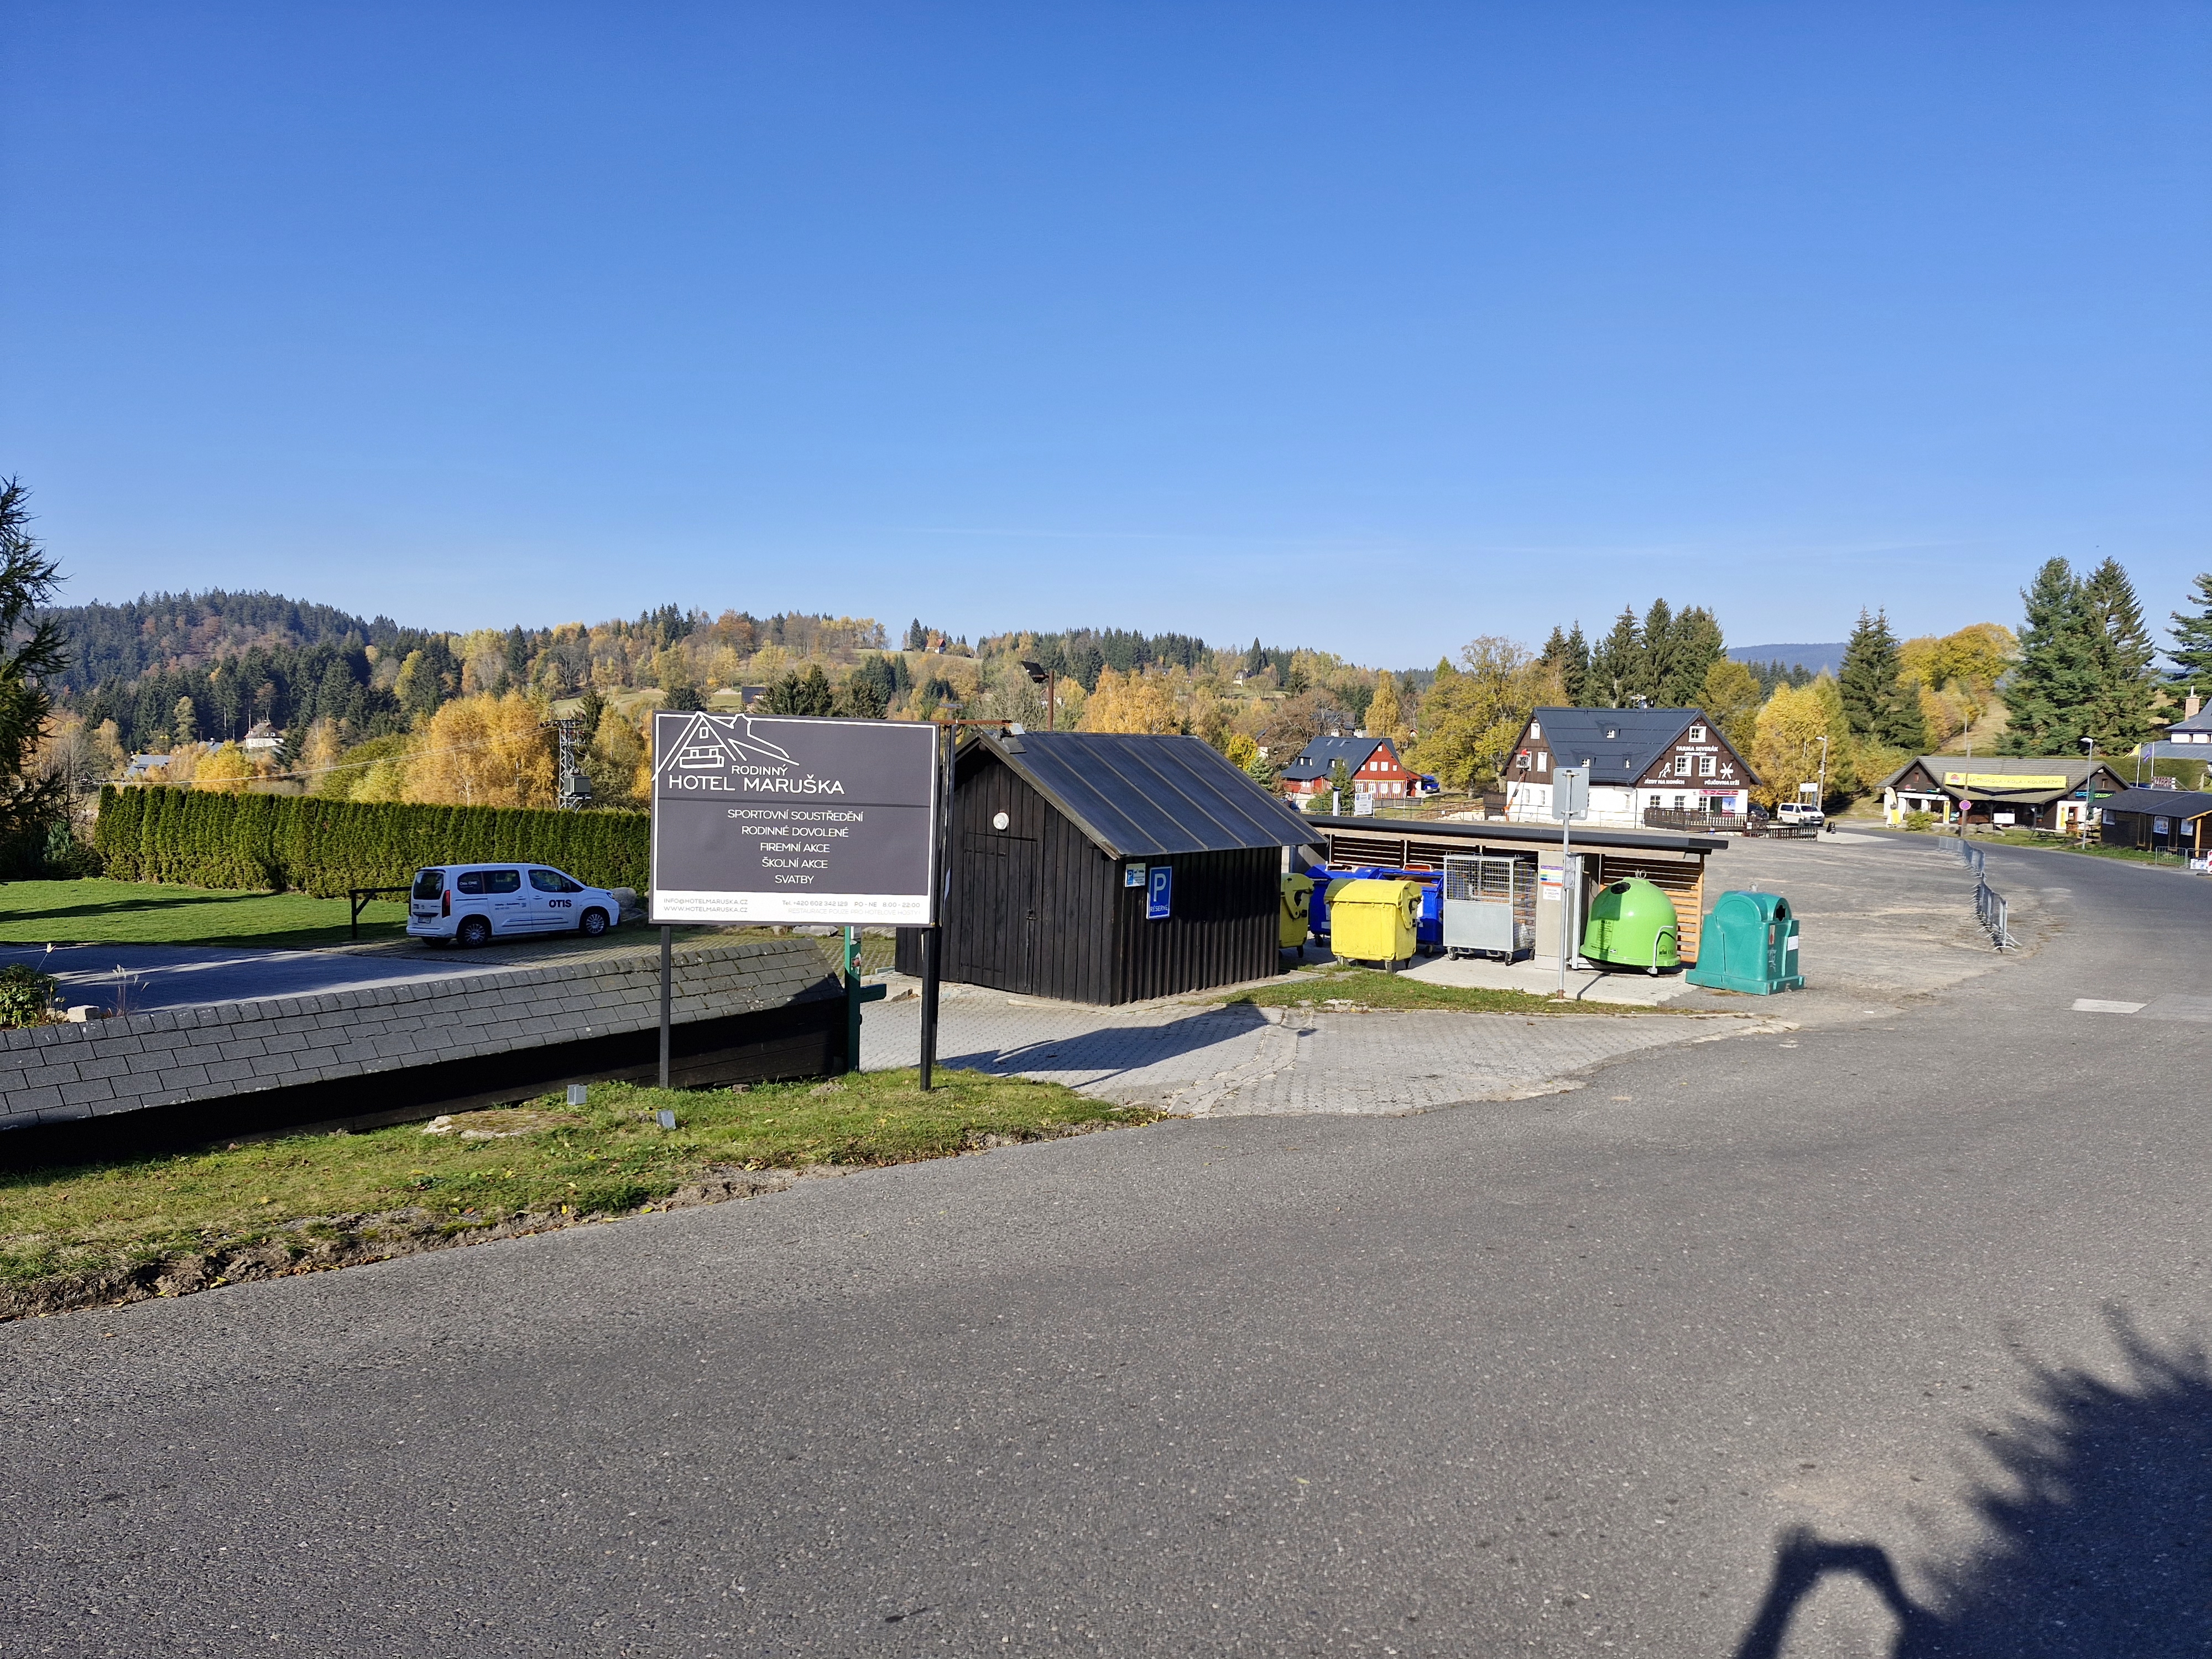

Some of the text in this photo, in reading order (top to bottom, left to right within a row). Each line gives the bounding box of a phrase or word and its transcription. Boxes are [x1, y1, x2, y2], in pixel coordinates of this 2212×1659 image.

[731, 764, 788, 776] RODINNÝ
[669, 774, 845, 795] HOTEL MARUŠKA
[727, 809, 864, 822] SPORTOVNÍ SOUSTŘEDĚNÍ
[742, 825, 849, 837] RODINNÉ DOVOLENÉ
[760, 841, 831, 853] FIREMNÍ AKCE
[761, 856, 828, 869] ŠKOLNÍ AKCE
[775, 874, 815, 884] SVATBY
[1154, 873, 1166, 902] P
[549, 899, 572, 907] OTIS
